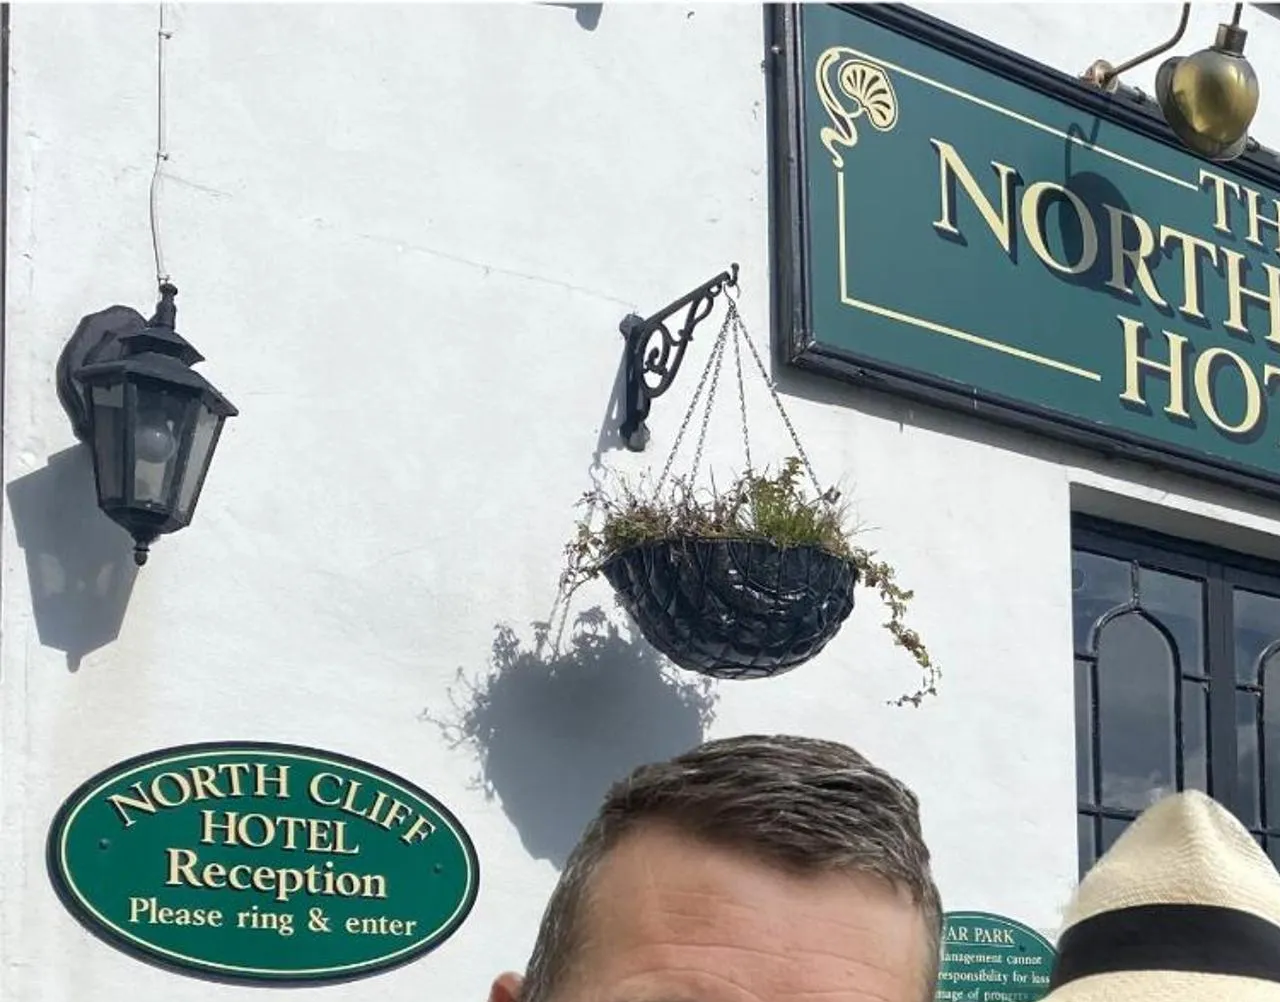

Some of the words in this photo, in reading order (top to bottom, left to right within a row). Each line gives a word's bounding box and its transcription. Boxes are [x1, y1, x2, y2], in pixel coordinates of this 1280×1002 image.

[107, 762, 292, 828] NORTH
[309, 772, 437, 846] CLIFF
[202, 810, 360, 855] HOTEL
[166, 848, 387, 901] Reception
[128, 897, 223, 928] Please
[237, 906, 294, 936] ring
[307, 907, 331, 933] &
[345, 914, 418, 937] enter
[974, 926, 1016, 944] PARK
[1006, 954, 1043, 965] cannot
[1013, 971, 1028, 983] for
[1032, 972, 1050, 984] loss
[967, 988, 979, 1000] of
